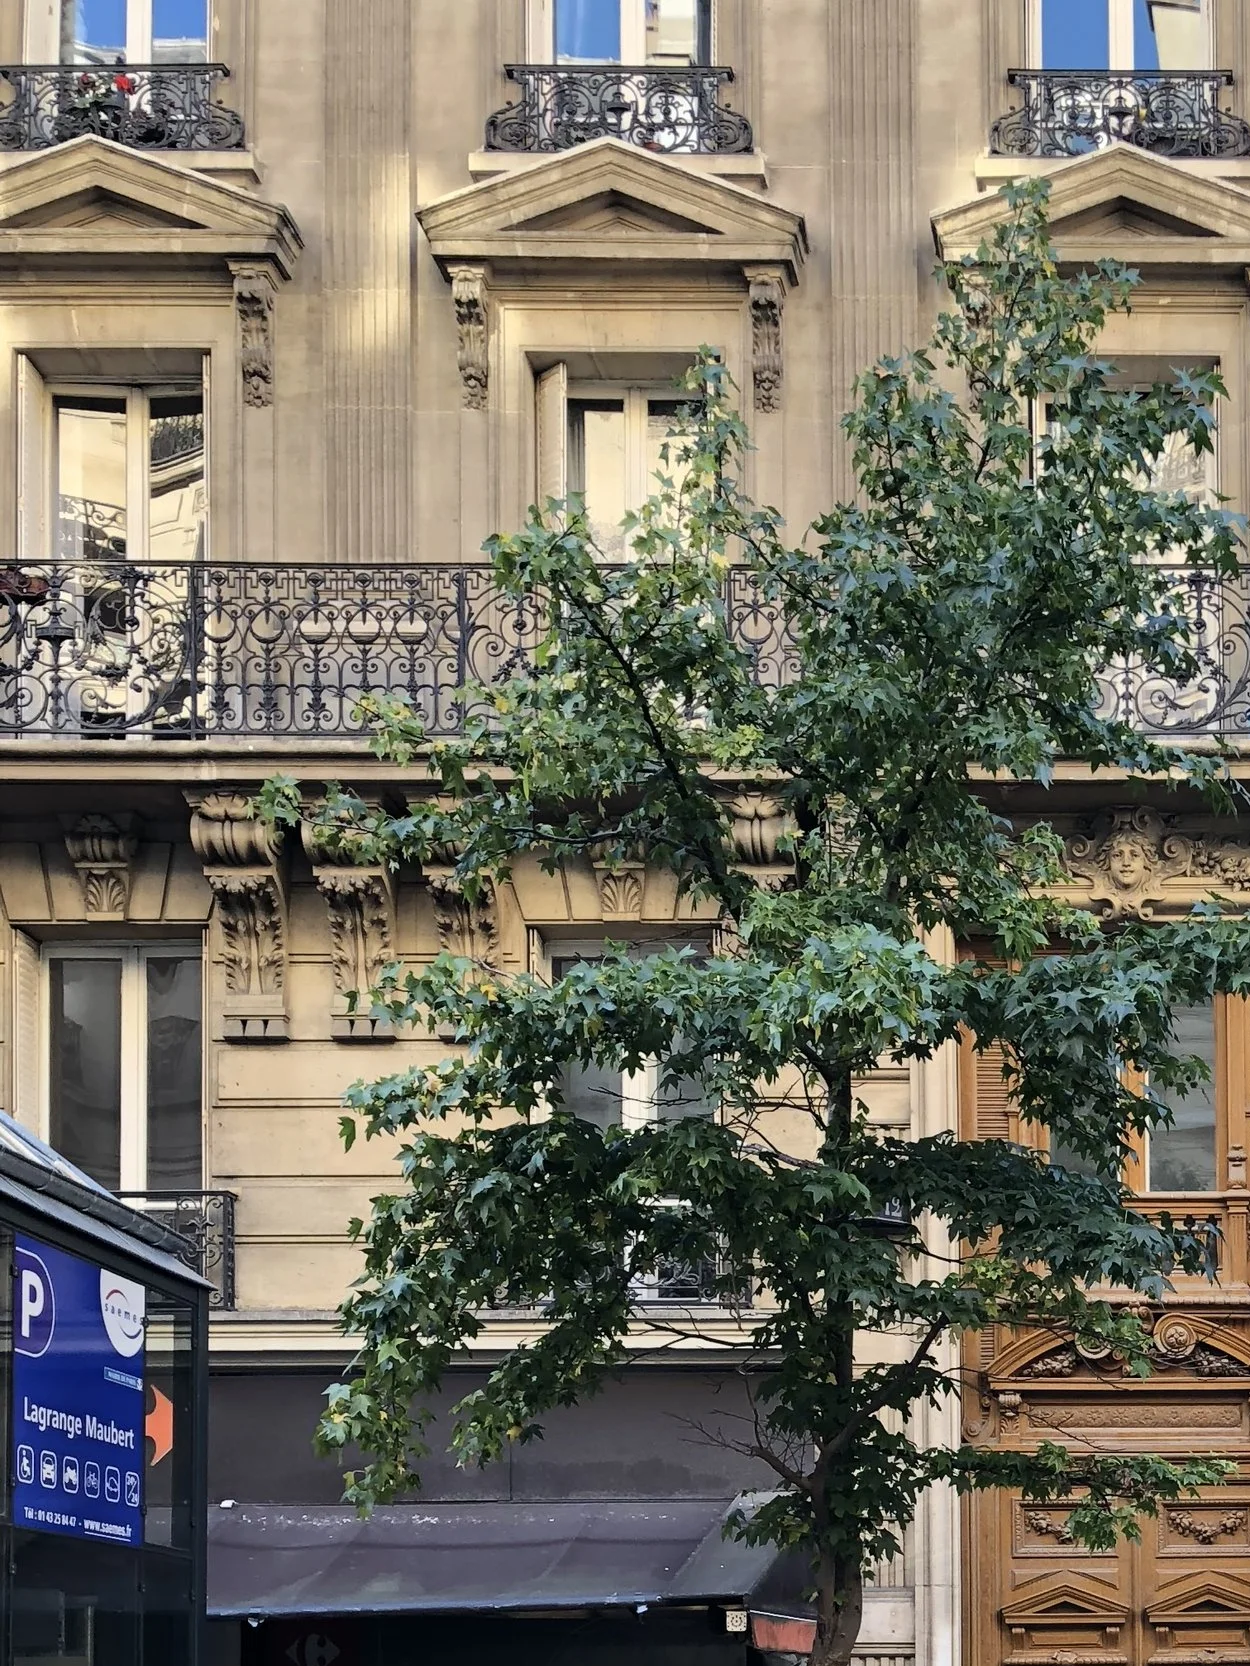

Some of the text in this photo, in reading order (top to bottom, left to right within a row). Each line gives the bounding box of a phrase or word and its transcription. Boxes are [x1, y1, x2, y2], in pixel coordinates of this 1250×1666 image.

[21, 1270, 44, 1338] P
[24, 1396, 135, 1450] Lagrange Maubert
[83, 1519, 132, 1538] www.saemes.fr
